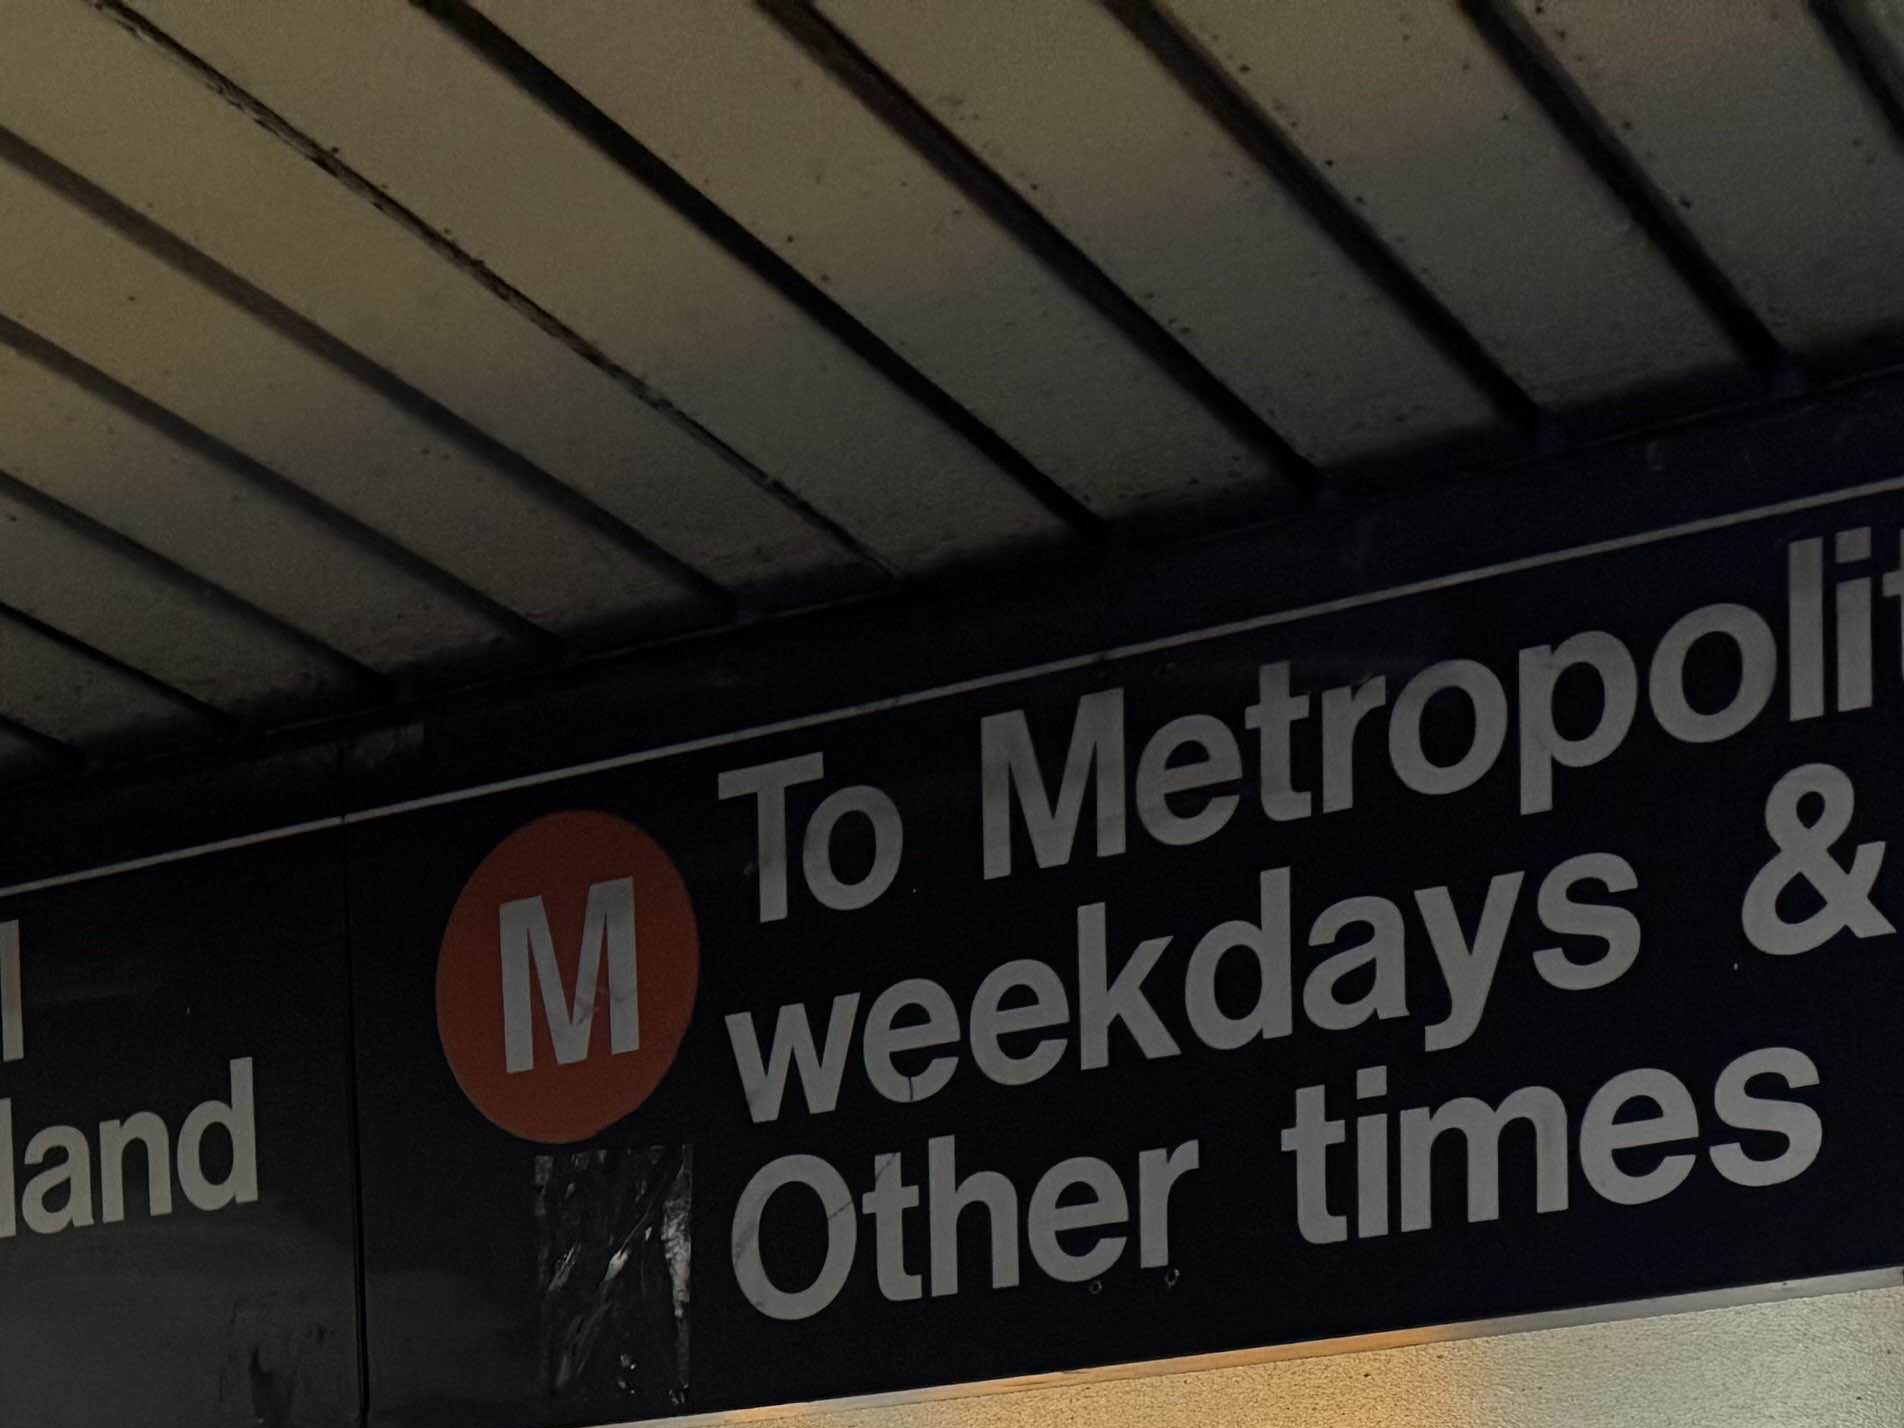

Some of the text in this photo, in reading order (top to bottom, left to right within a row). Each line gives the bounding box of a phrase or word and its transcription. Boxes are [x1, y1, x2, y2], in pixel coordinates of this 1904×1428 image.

[718, 752, 903, 923] To
[725, 851, 1641, 1124] weekdays
[1741, 763, 1896, 956] &
[500, 876, 640, 1074] M
[732, 1135, 1199, 1321] Other
[1281, 1046, 1822, 1244] times
